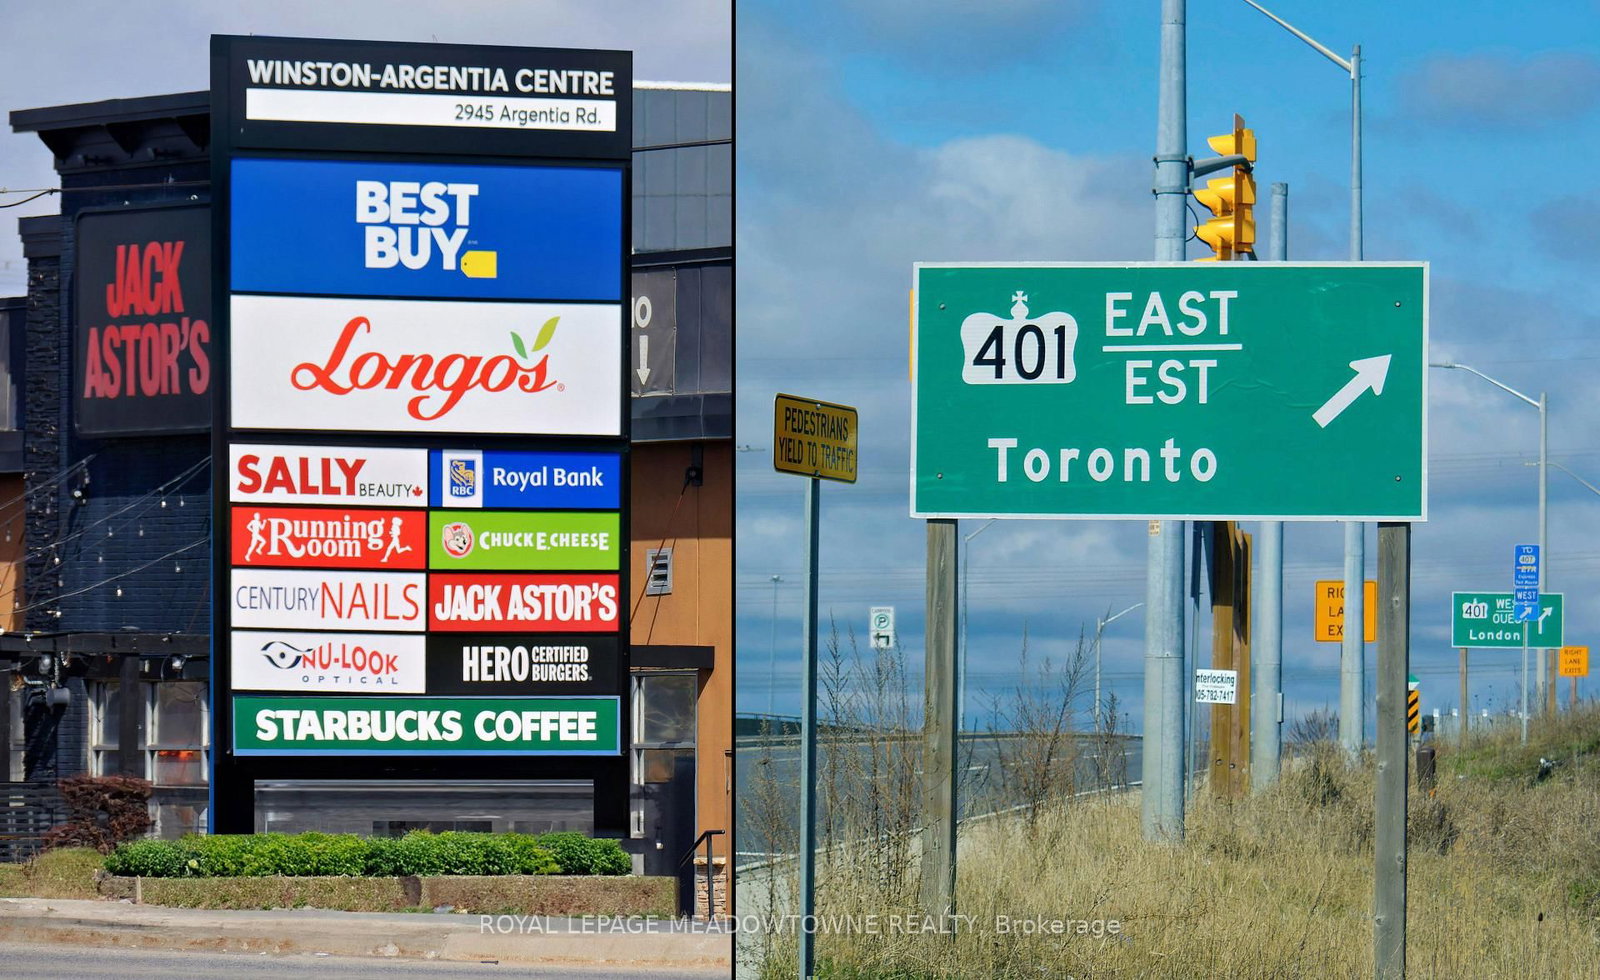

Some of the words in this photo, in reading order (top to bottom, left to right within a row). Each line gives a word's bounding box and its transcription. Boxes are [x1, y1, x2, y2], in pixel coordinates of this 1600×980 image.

[247, 59, 509, 92] WINSTON-ARGENTIA
[515, 68, 615, 95] CENTRE
[455, 104, 494, 121] 2945
[500, 105, 570, 127] Argentia
[575, 107, 601, 125] Rd.
[356, 180, 479, 226] BEST
[365, 226, 469, 270] BUY
[106, 240, 185, 318] JACK
[1105, 290, 1238, 336] EAST
[84, 317, 210, 398] ASTOR'S
[972, 324, 1066, 380] 401
[1125, 359, 1217, 405] EST
[784, 406, 849, 442] PEDESTRIANS
[779, 436, 804, 465] YIELD
[807, 441, 818, 467] TO
[821, 443, 854, 473] TRAFFIC
[988, 437, 1217, 482] Toronto
[237, 454, 367, 495] SALLY
[359, 483, 411, 498] BEAUTY
[452, 486, 474, 496] RBC
[493, 467, 549, 491] Royal
[553, 467, 604, 487] Bank
[267, 516, 385, 555] Running
[480, 531, 534, 550] CHUCK
[551, 531, 610, 551] CHEESE
[1521, 546, 1533, 554] TO
[236, 585, 319, 613] CENTURY
[321, 581, 419, 621] NAILS
[435, 584, 503, 621] JACK
[507, 584, 618, 622] ASTOR'S
[1328, 606, 1344, 617] LA
[1465, 605, 1485, 617] 401
[1496, 598, 1515, 609] WE
[1517, 592, 1537, 600] WEST
[1469, 629, 1520, 640] London
[1493, 613, 1522, 624] OUE
[301, 642, 399, 675] NU-LOOK
[463, 645, 529, 682] HERO
[532, 646, 589, 664] CERTIFIED
[301, 675, 399, 685] OPTICAL
[532, 664, 589, 682] BURGERS
[1196, 673, 1235, 687] nterlocking
[1197, 689, 1234, 702] 05-782-7417
[255, 709, 463, 742] STARBUCKS
[474, 710, 598, 742] COFFEE
